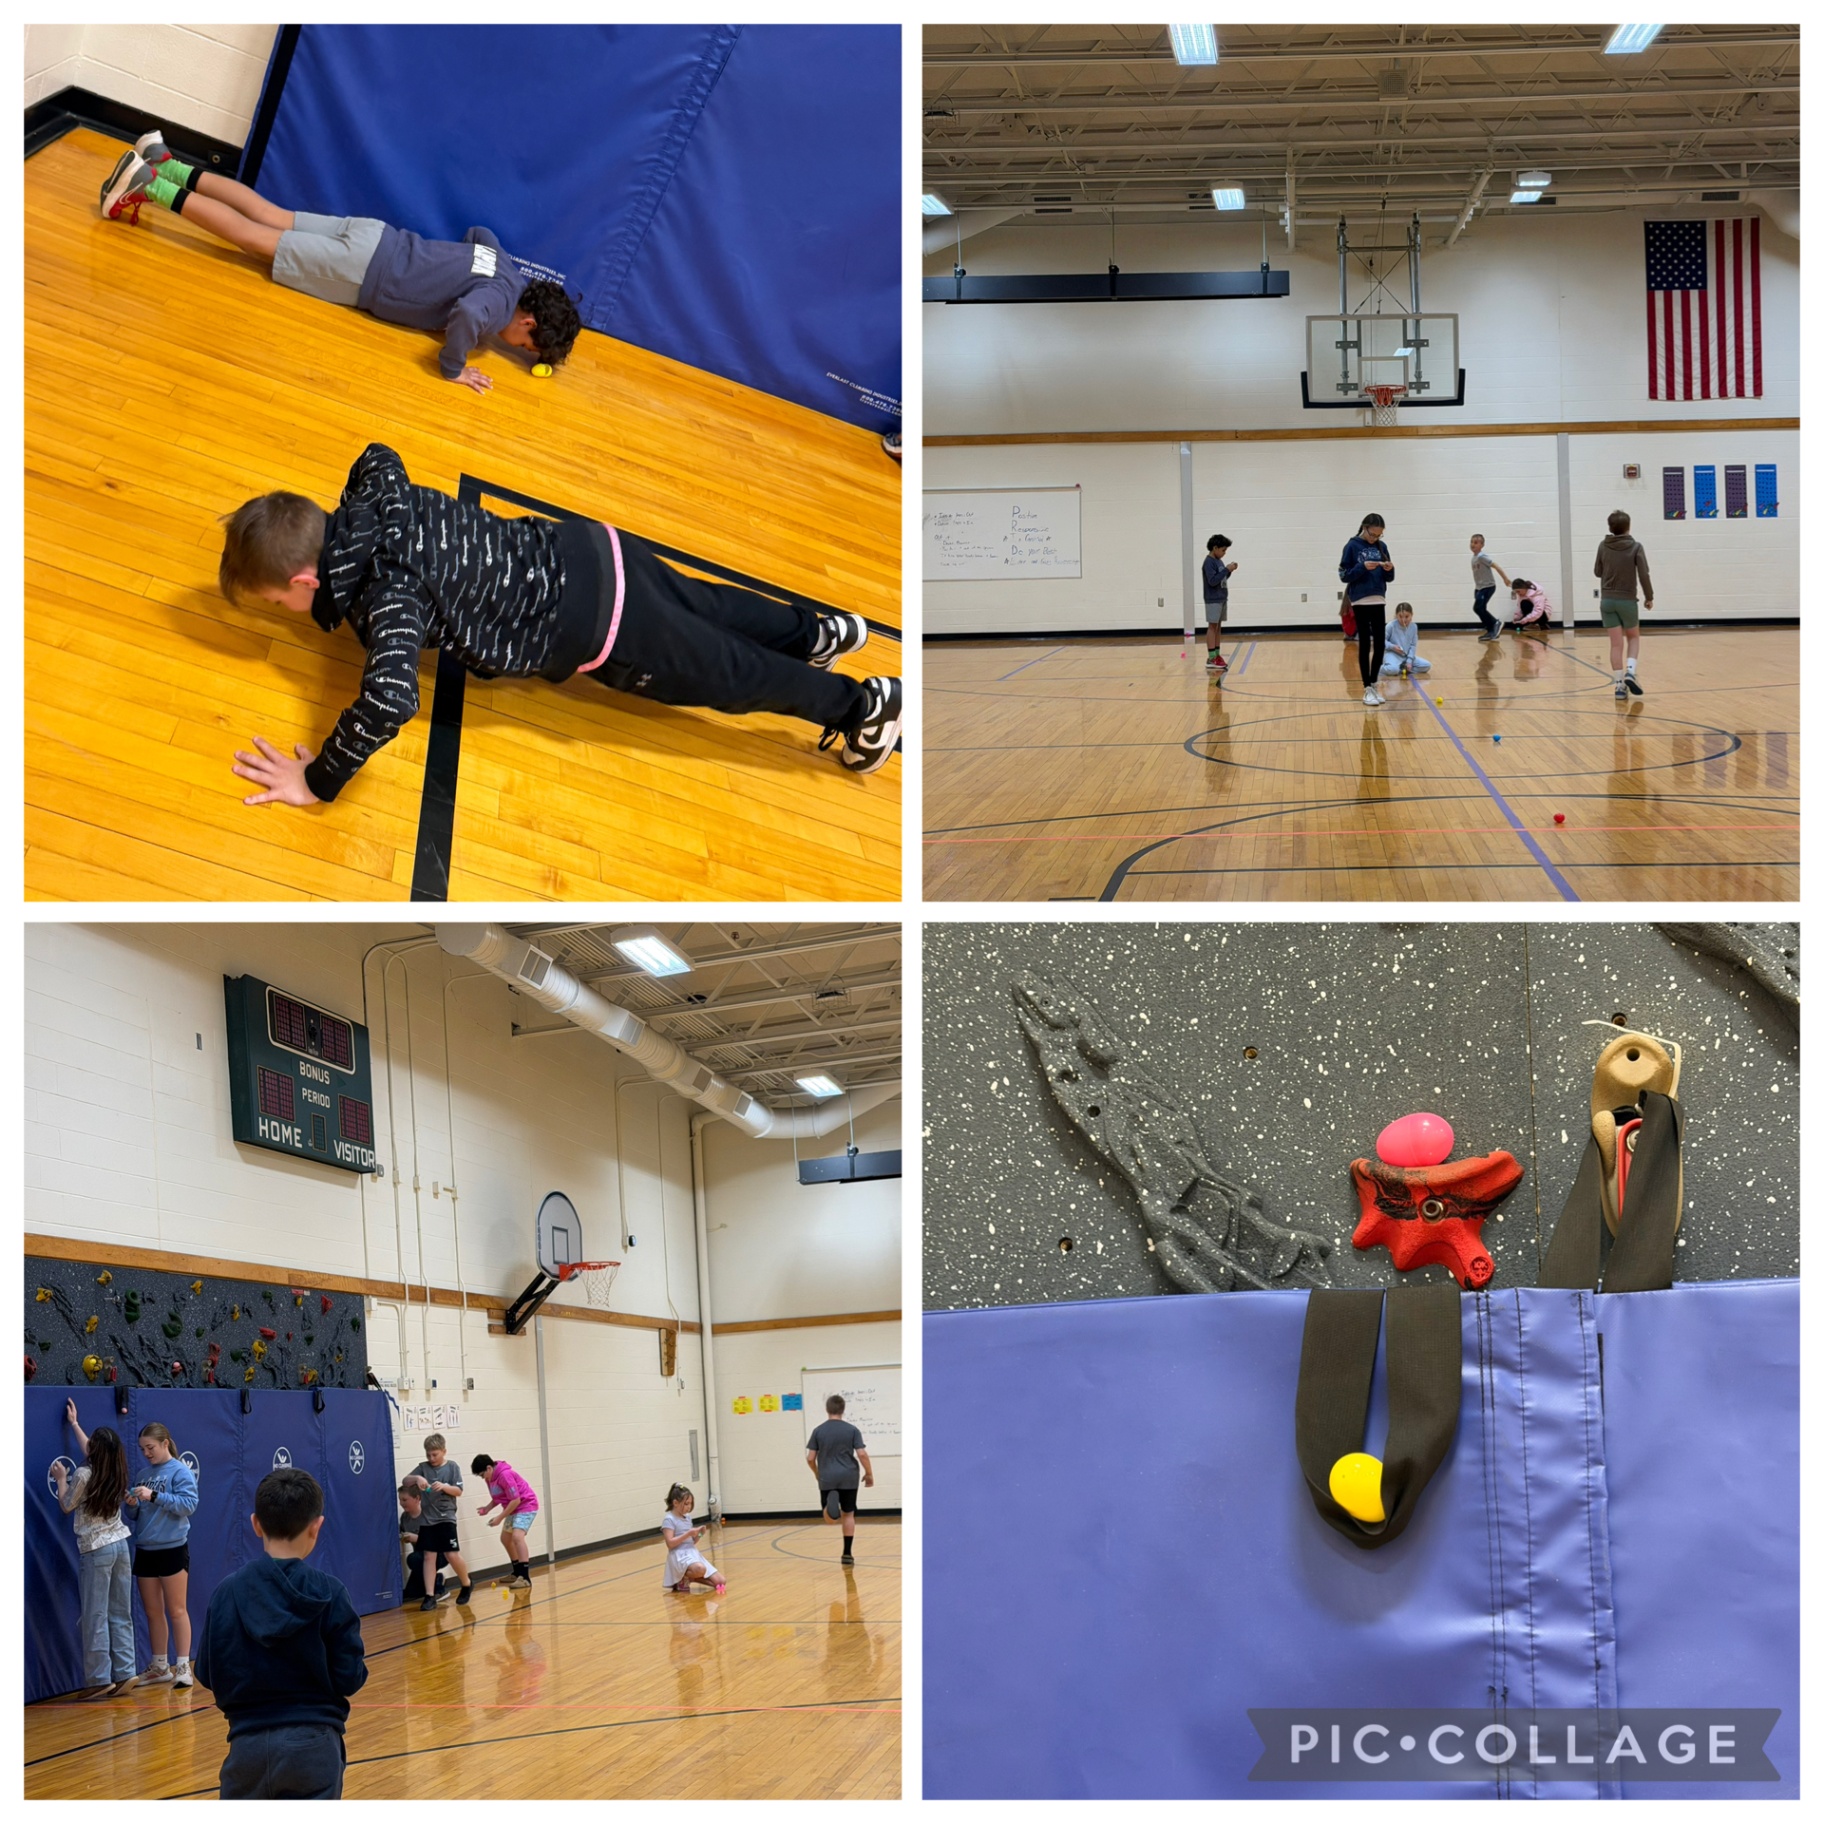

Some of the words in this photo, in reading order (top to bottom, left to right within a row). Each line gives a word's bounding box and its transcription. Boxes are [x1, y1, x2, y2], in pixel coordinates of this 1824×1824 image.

[826, 371, 850, 385] EVERLAST
[299, 1060, 331, 1086] BONUS
[301, 1087, 331, 1109] PERIOD
[258, 1116, 303, 1149] HOME
[333, 1138, 376, 1169] VISITOR
